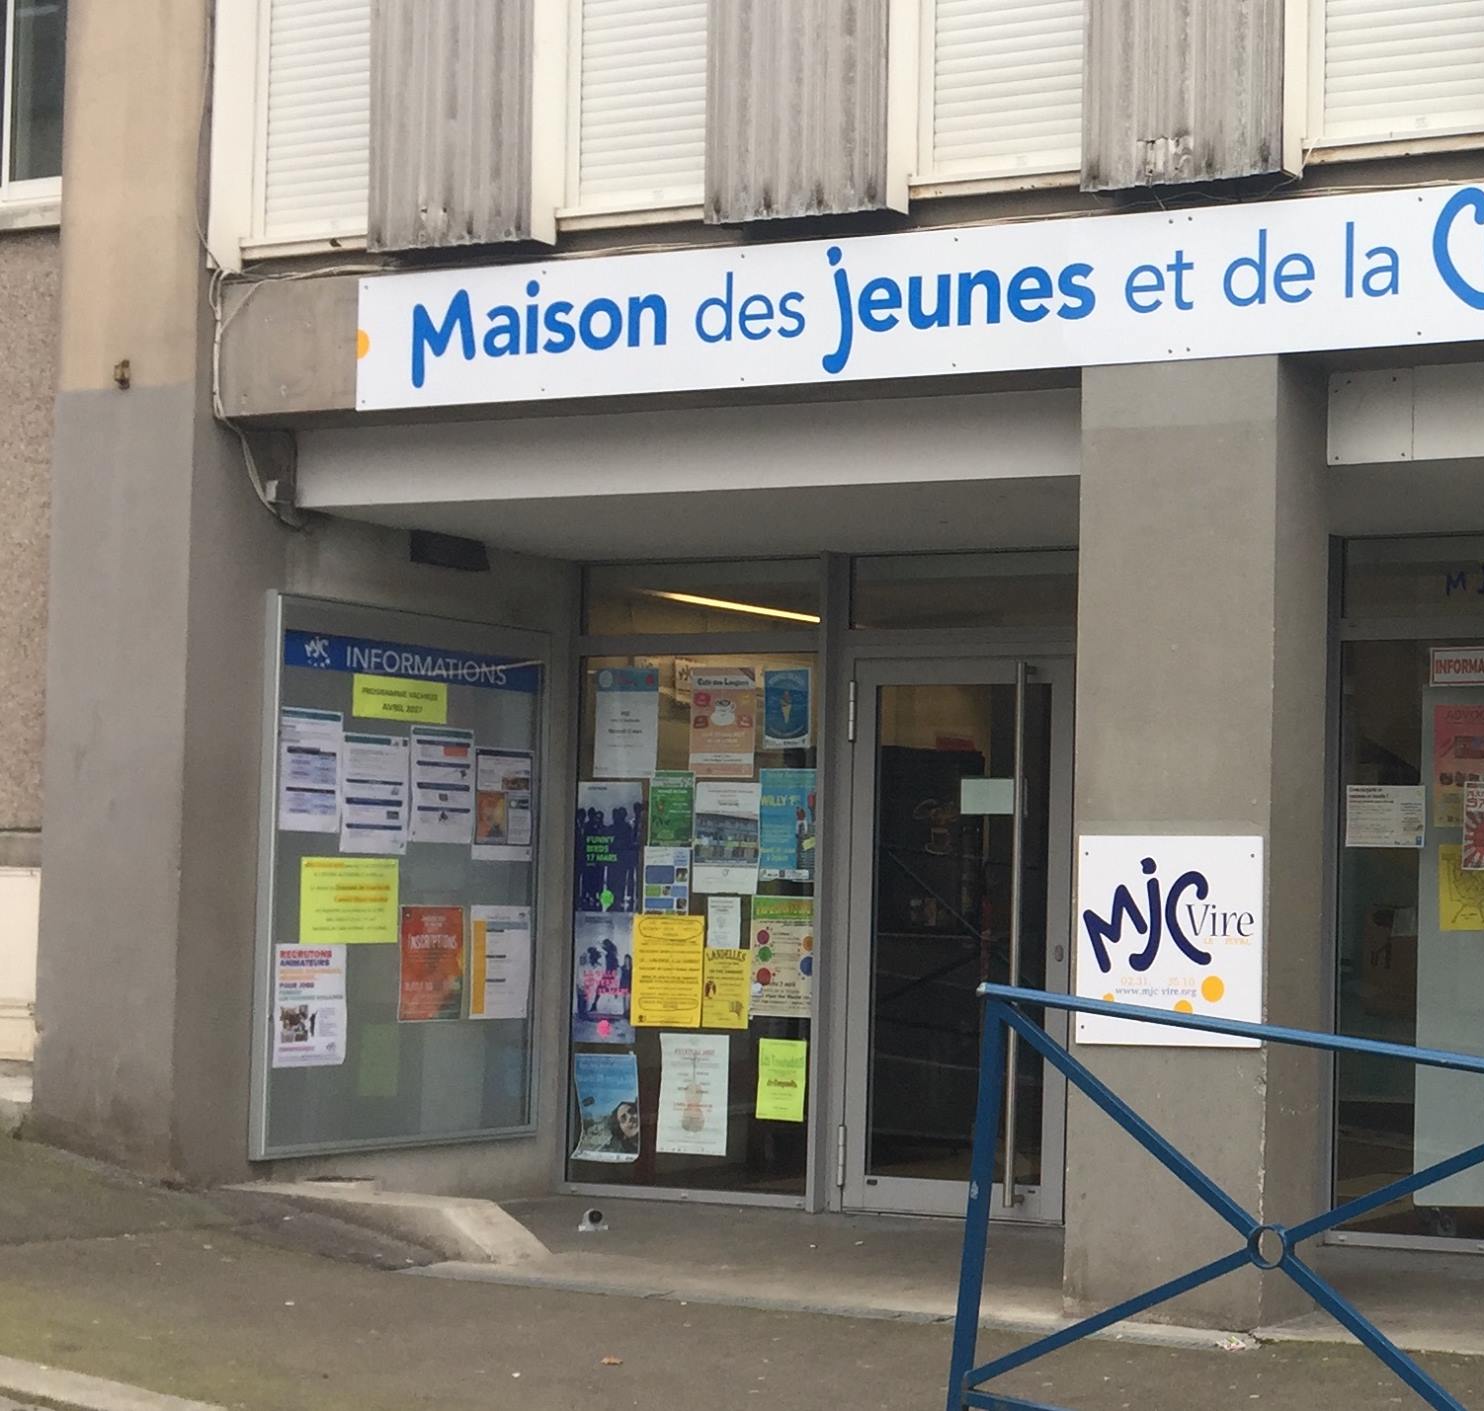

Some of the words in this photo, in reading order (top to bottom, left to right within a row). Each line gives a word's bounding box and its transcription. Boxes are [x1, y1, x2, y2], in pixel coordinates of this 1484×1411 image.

[411, 280, 667, 388] Maison
[695, 272, 806, 342] des
[822, 246, 1096, 373] jeunes
[1125, 249, 1194, 314] et
[1222, 228, 1315, 304] de
[1345, 221, 1400, 298] la
[346, 646, 507, 685] INFORMATIONS
[1186, 904, 1255, 937] Vire
